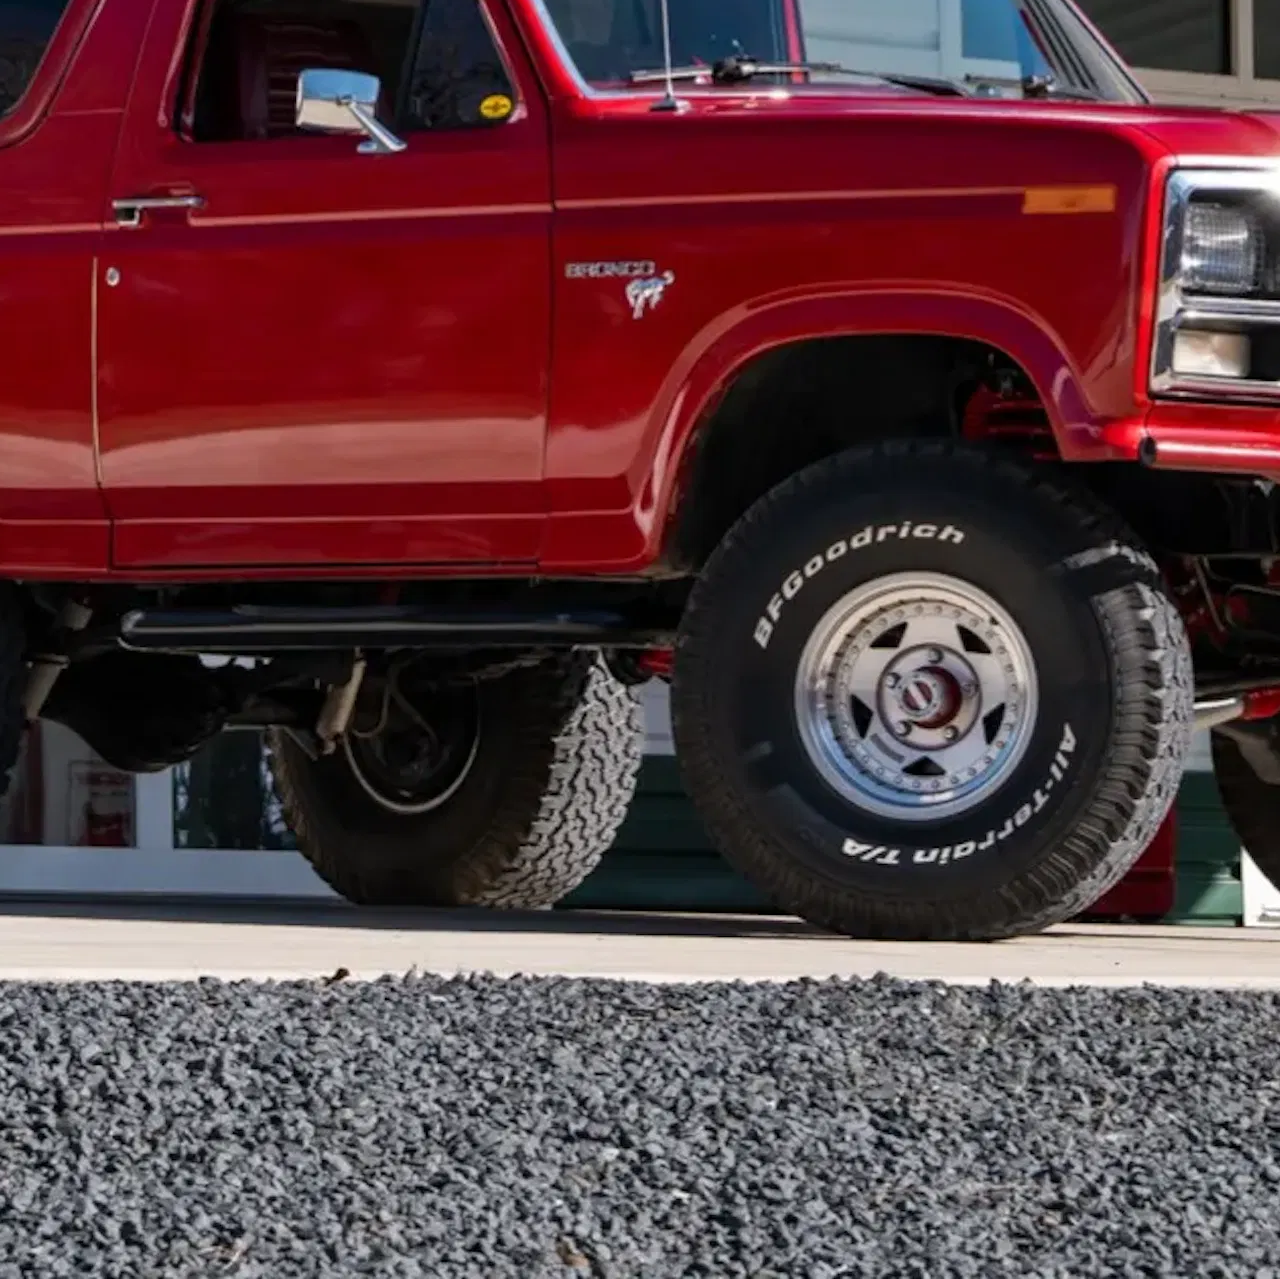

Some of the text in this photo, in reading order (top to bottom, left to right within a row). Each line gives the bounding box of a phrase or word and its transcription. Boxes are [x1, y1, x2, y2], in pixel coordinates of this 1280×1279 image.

[753, 521, 967, 650] BFGoodrich
[841, 722, 1077, 866] All-Terrain T/A
